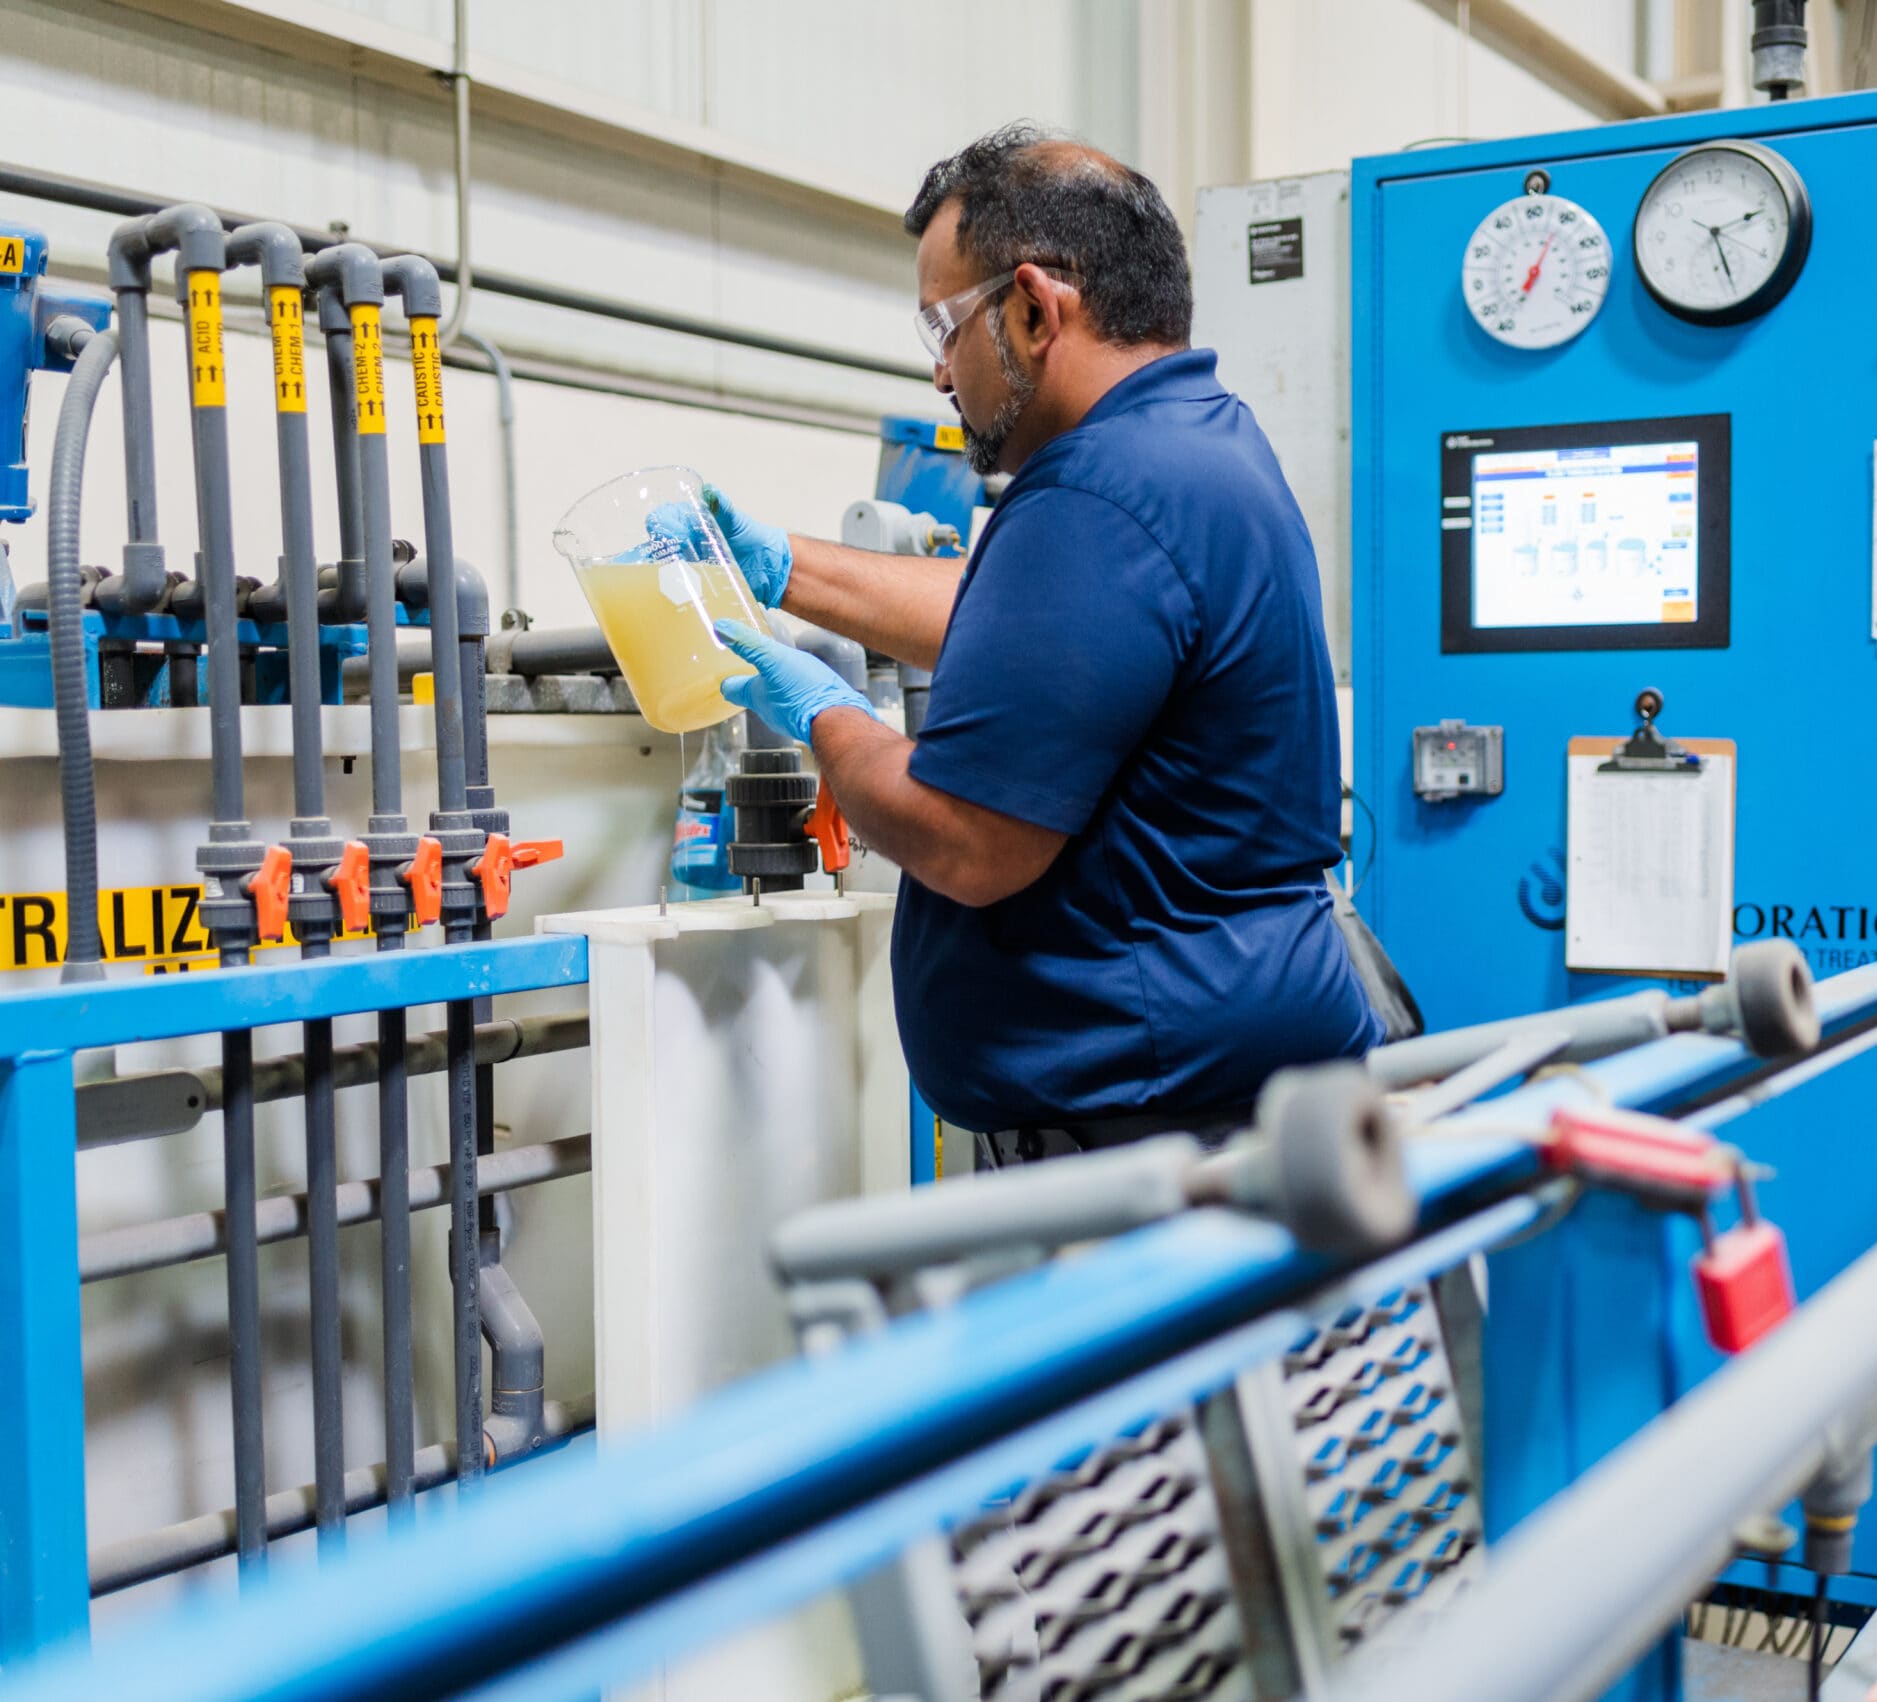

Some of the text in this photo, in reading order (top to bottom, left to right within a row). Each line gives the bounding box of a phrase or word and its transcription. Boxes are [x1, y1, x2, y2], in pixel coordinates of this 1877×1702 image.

[1683, 180, 1696, 193] 11
[1706, 168, 1723, 184] 12
[0, 243, 17, 267] A
[196, 320, 213, 355] ACID
[289, 323, 304, 376] CHEM-1
[354, 342, 370, 395] CHEM-2
[413, 351, 430, 408] CAUSTIC
[1733, 903, 1877, 940] ORATI
